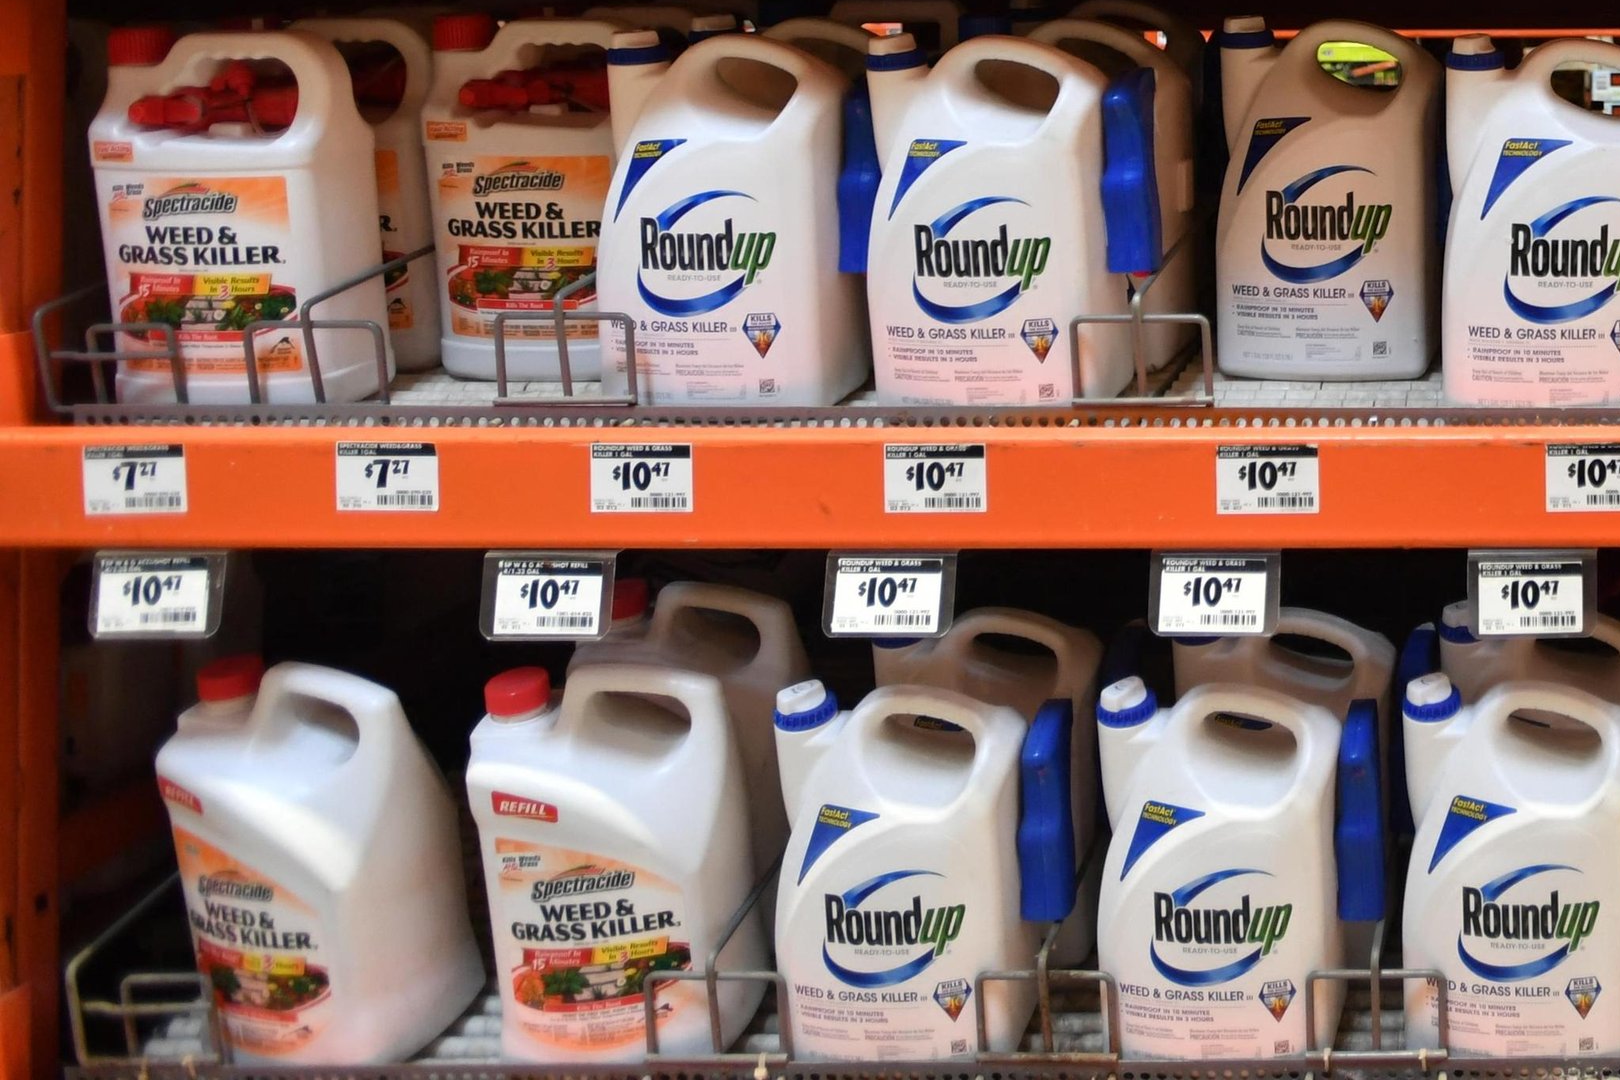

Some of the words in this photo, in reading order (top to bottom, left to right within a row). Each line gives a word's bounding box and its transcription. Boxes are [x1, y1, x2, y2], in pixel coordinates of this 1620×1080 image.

[472, 172, 564, 196] Spectracide
[143, 194, 237, 219] Spectracide
[475, 202, 541, 220] WEED
[544, 202, 563, 220] &
[448, 219, 516, 238] GRASS
[1265, 190, 1392, 256] Roundup
[145, 226, 213, 246] WEED
[217, 226, 237, 246] &
[119, 244, 188, 265] GRASS
[640, 217, 777, 285] Roundup
[914, 224, 1051, 291] Roundup
[500, 801, 547, 816] REFILL
[531, 871, 635, 901] Spectracide
[540, 901, 612, 923] WEED
[616, 898, 634, 916] &
[1462, 886, 1600, 952] Roundup
[512, 921, 586, 942] GRASS
[824, 893, 966, 957] Roundup
[1154, 892, 1293, 956] Roundup
